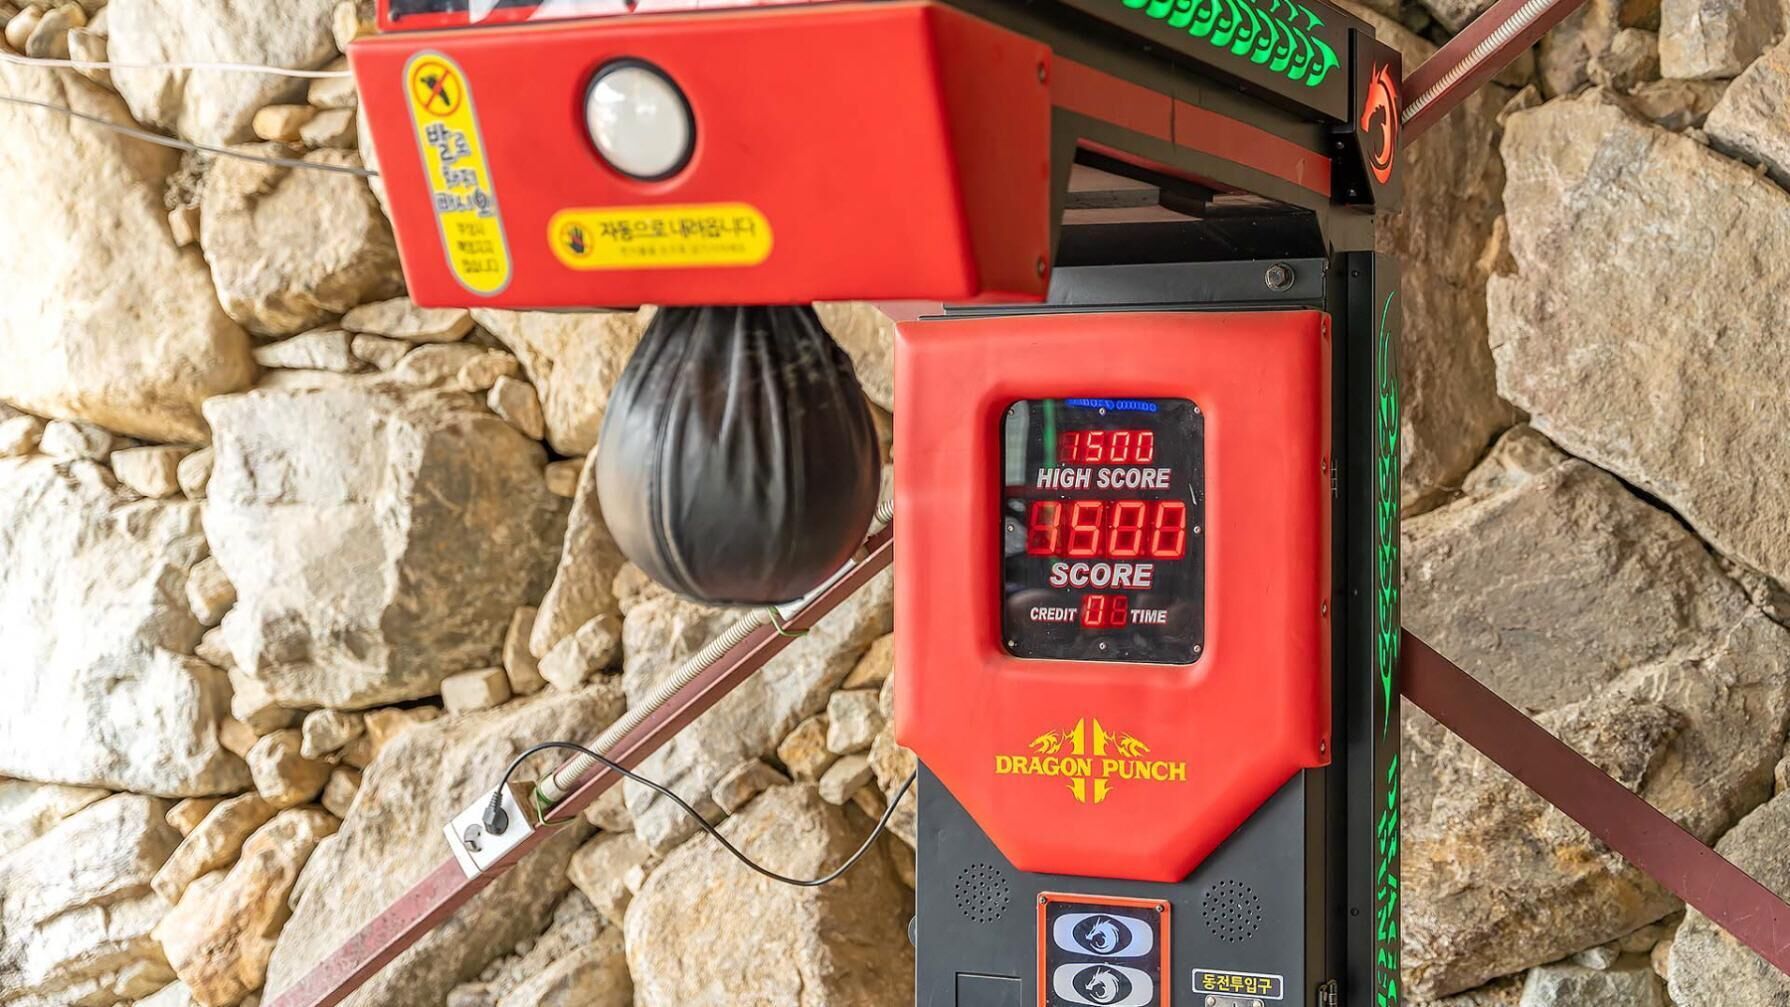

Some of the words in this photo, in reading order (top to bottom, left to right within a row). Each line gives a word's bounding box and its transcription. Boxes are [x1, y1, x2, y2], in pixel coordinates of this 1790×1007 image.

[425, 122, 471, 164] 발로
[599, 219, 668, 241] 자동으로
[1071, 431, 1154, 462] 1500
[1036, 467, 1091, 489] HIGH
[1096, 467, 1172, 489] SCORE
[1048, 501, 1187, 557] 1500
[1049, 562, 1153, 588] SCORE
[1030, 606, 1077, 622] CREDIT
[1130, 609, 1168, 624] TIME
[995, 755, 1093, 777] DRAGON
[1102, 758, 1187, 781] PUNCH
[1202, 973, 1272, 995] 동전투입구
